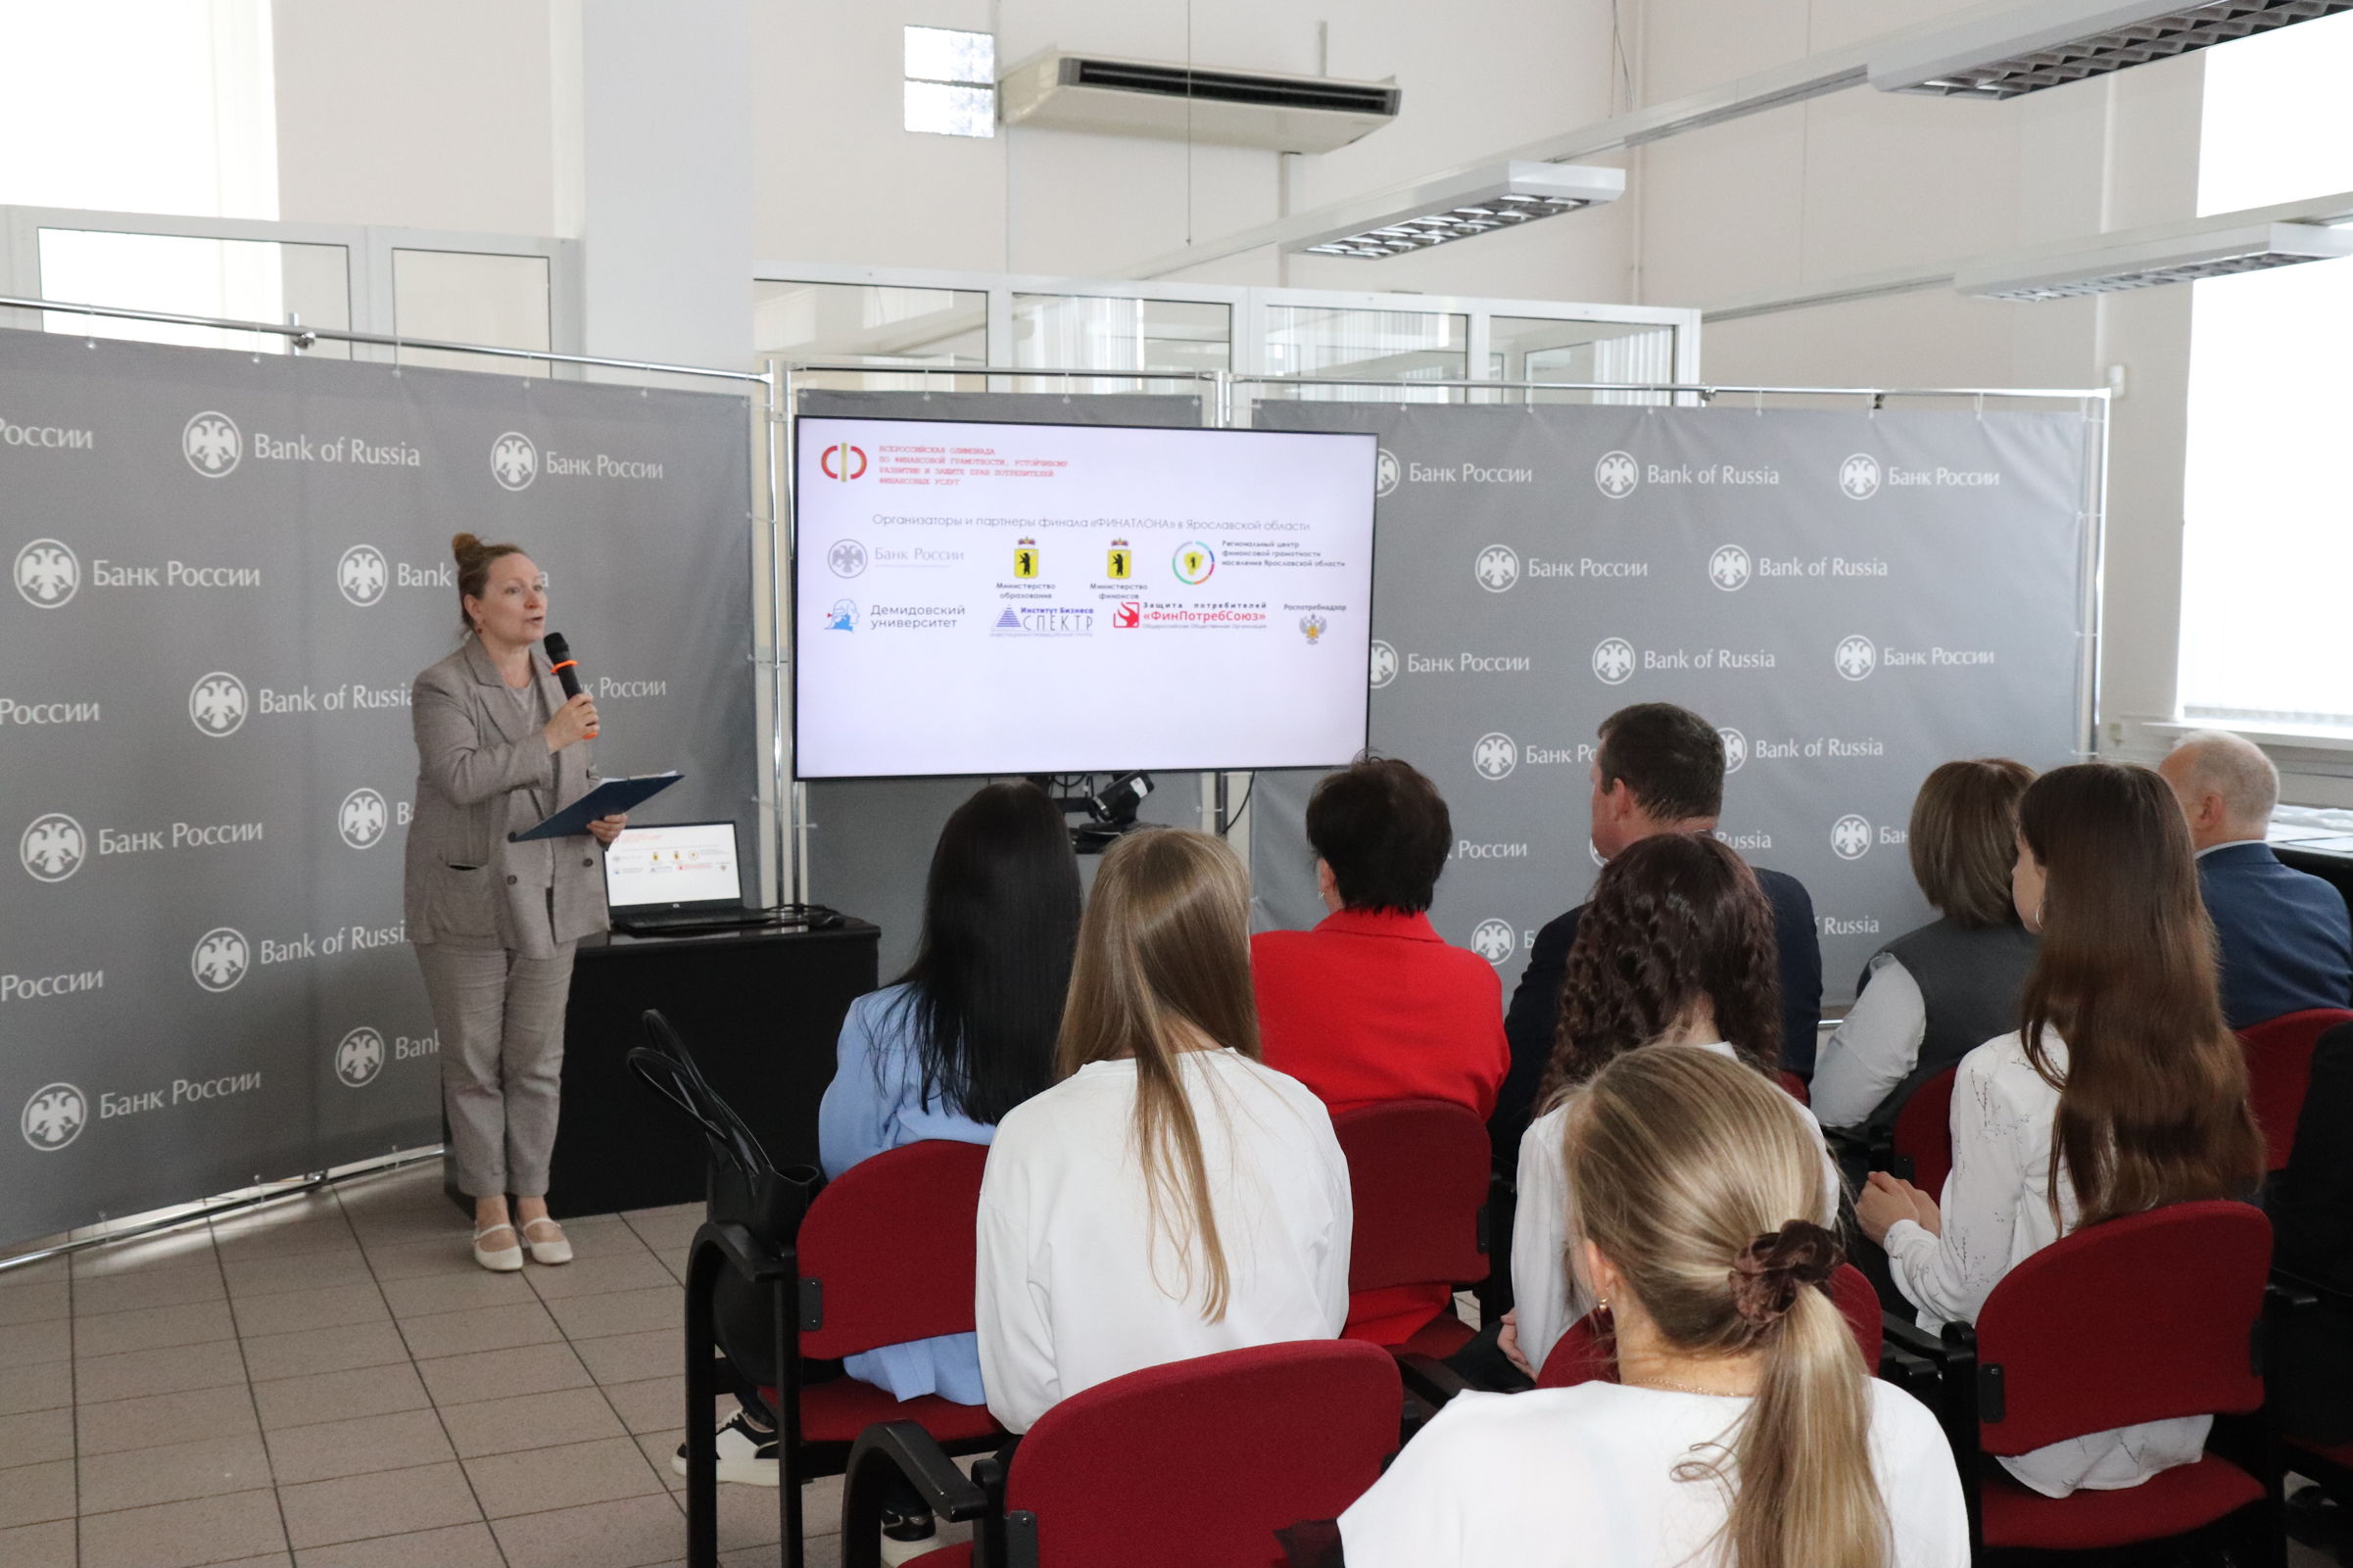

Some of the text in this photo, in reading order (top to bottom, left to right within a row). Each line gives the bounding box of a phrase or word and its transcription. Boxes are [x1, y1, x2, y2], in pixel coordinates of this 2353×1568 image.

[255, 434, 421, 466] Bank of Russia
[546, 451, 663, 479] Банк России
[1409, 462, 1532, 483] Банк России
[1647, 463, 1779, 485] Bank of Russia
[1889, 467, 1999, 487] Банк России
[872, 513, 963, 528] Организаторы
[976, 516, 1035, 529] партнеры
[1038, 514, 1088, 529] финала
[1090, 517, 1176, 530] «ФИНАТЛОНА»
[1185, 519, 1262, 532] Ярославской
[1264, 519, 1311, 532] области
[874, 547, 965, 562] Банк России
[1222, 540, 1300, 550] Региональный центр
[1222, 549, 1321, 560] финансовой грамотности
[93, 560, 261, 588] Банк России
[398, 562, 452, 587] Bank
[1222, 559, 1346, 570] населения Ярославской области
[1528, 558, 1648, 578] Банк России
[1758, 556, 1889, 576] Bank of Russia
[995, 582, 1056, 592] Министерство
[999, 591, 1052, 601] образования
[1089, 582, 1148, 592] Министерство
[1098, 593, 1139, 602] финансов
[1193, 601, 1268, 610] потребителей
[870, 604, 966, 618] Демидовский
[1020, 606, 1094, 615] Институт Бизнеса
[1143, 610, 1267, 624] «ФинПотребСоюз»
[1283, 603, 1347, 613] Роспотребнадзор
[870, 618, 957, 631] университет
[1023, 614, 1093, 632] СПЕКТР
[1407, 653, 1530, 673] Банк России
[1644, 648, 1775, 669] Bank of Russia
[1884, 646, 1994, 666] Банк России
[600, 676, 666, 698] России
[260, 686, 317, 714] Bank
[323, 684, 347, 710] of
[0, 697, 99, 725] России
[1525, 744, 1571, 764] Банк
[1754, 737, 1883, 759] Bank of Russia
[98, 821, 264, 855] Банк России
[1880, 826, 1908, 844] Бан
[1458, 840, 1528, 859] России
[1824, 915, 1880, 935] Russia
[260, 920, 408, 965] Bank of Russi
[0, 969, 104, 1002] России
[99, 1070, 262, 1119] Банк России
